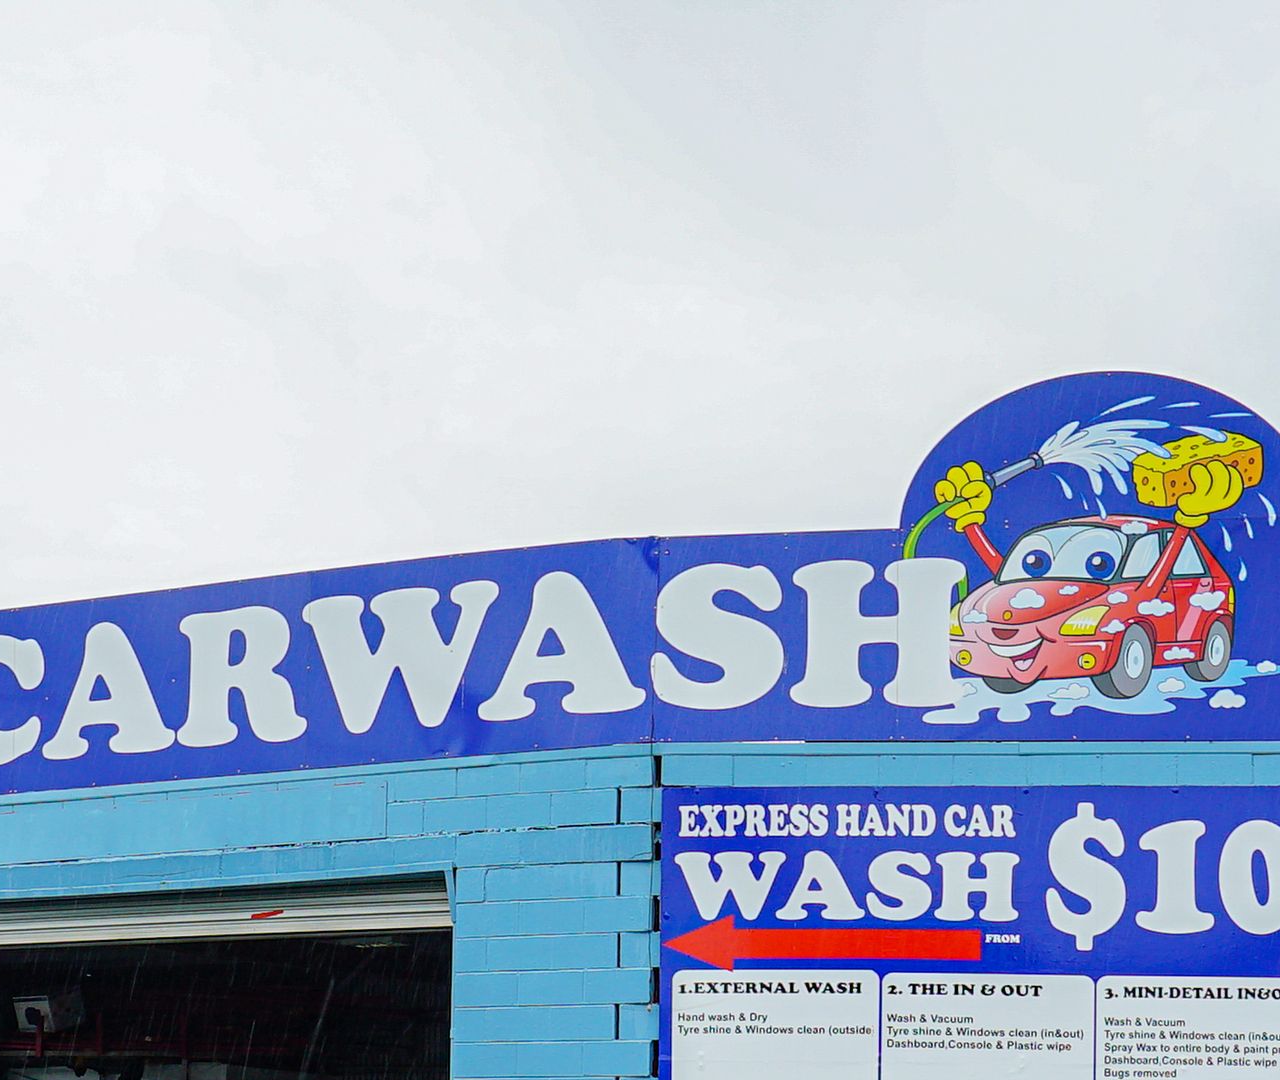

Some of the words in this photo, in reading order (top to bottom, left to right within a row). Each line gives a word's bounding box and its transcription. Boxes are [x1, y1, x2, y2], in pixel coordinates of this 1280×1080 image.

[679, 804, 828, 836] EXPRESS
[836, 804, 936, 836] HAND
[944, 805, 1016, 837] CAR
[675, 851, 1019, 921] WASH
[986, 934, 1020, 943] FROM
[804, 982, 861, 994] WASH
[888, 985, 903, 995] 2.
[908, 983, 948, 995] THE
[953, 984, 975, 995] IN
[980, 984, 996, 996] &
[1001, 985, 1043, 997] OUT
[1105, 988, 1118, 999] 3.
[1124, 987, 1233, 999] MINI-DETAIL
[678, 1013, 705, 1022] Hand
[708, 1013, 735, 1022] wash
[738, 1012, 746, 1021] &
[750, 1012, 768, 1023] Dry
[887, 1014, 916, 1023] Wash
[919, 1014, 927, 1023] &
[930, 1014, 973, 1024] Vacuum
[887, 1026, 909, 1037] Tyre
[912, 1027, 942, 1036] shine
[945, 1027, 953, 1036] &
[956, 1027, 1005, 1037] Windows
[1008, 1028, 1037, 1037] clean
[1041, 1029, 1084, 1040] (in&out)
[996, 1040, 1003, 1050] &
[1007, 1041, 1043, 1050] Plastic
[1046, 1042, 1072, 1053] wipe
[1104, 1042, 1133, 1054] Spray
[1136, 1043, 1157, 1052] Wax
[1160, 1044, 1170, 1052] to
[1173, 1044, 1202, 1053] entire
[1205, 1044, 1230, 1055] body
[1233, 1044, 1240, 1053] &
[1244, 1045, 1269, 1055] paint
[1104, 1068, 1130, 1080] Bugs
[1133, 1069, 1177, 1078] removed
